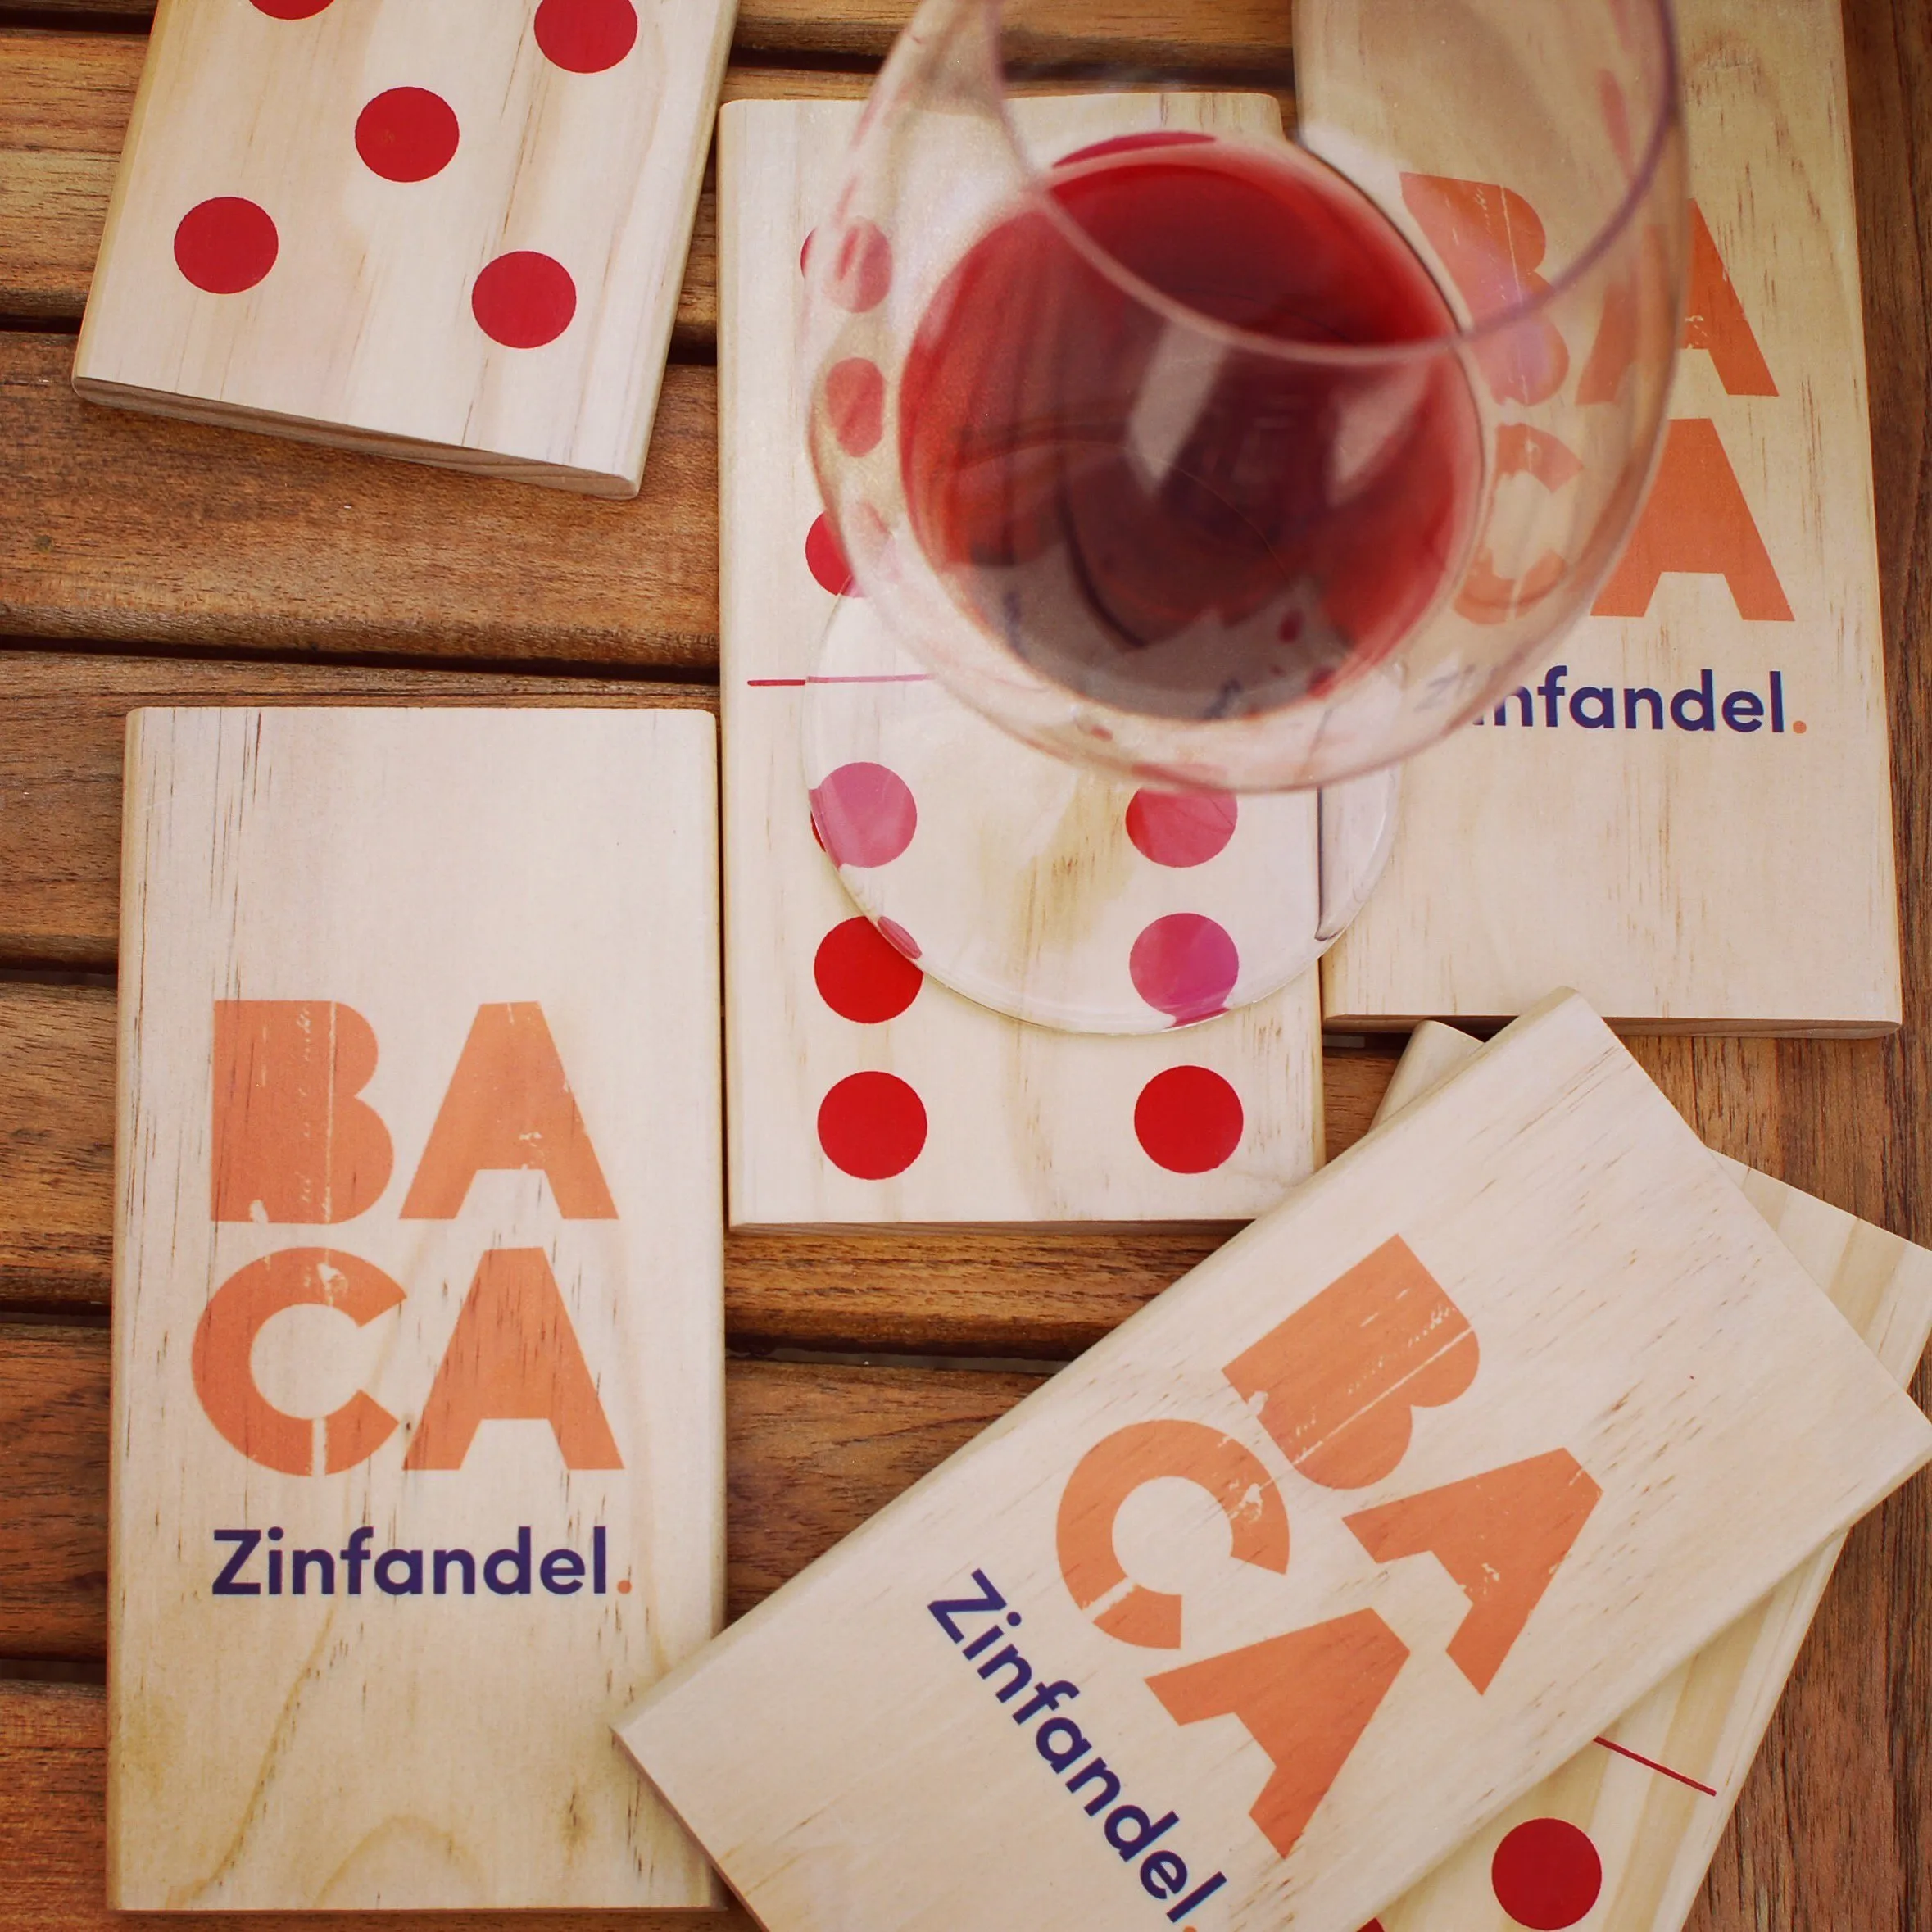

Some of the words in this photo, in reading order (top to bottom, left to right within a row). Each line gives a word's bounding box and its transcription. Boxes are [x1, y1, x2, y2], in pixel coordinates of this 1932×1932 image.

[1401, 171, 1780, 406] BA
[1453, 417, 1796, 623] CA
[1472, 665, 1807, 734] nfandel.
[211, 999, 620, 1225] BA
[190, 1246, 625, 1477] CA
[1221, 1232, 1604, 1697] BA
[211, 1526, 633, 1596] Zinfandel.
[1055, 1418, 1411, 1861] CA
